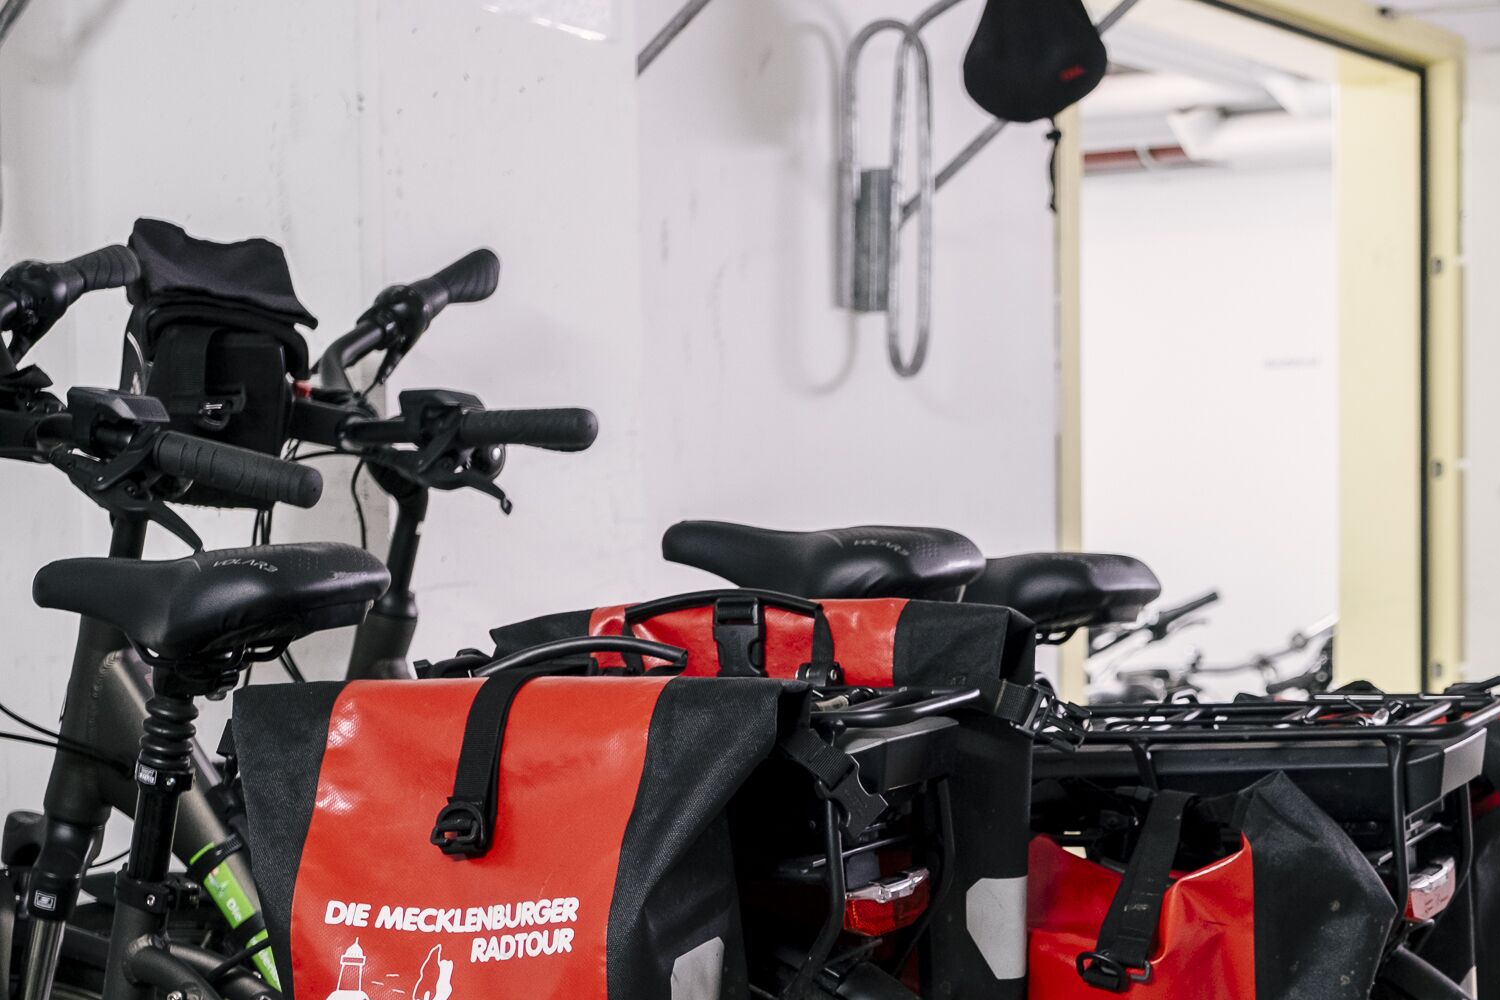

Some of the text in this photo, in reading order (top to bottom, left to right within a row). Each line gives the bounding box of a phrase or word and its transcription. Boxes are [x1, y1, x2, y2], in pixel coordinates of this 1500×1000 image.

[324, 897, 580, 933] DIE MECKLENBURGER
[470, 927, 575, 963] RADTOUR
